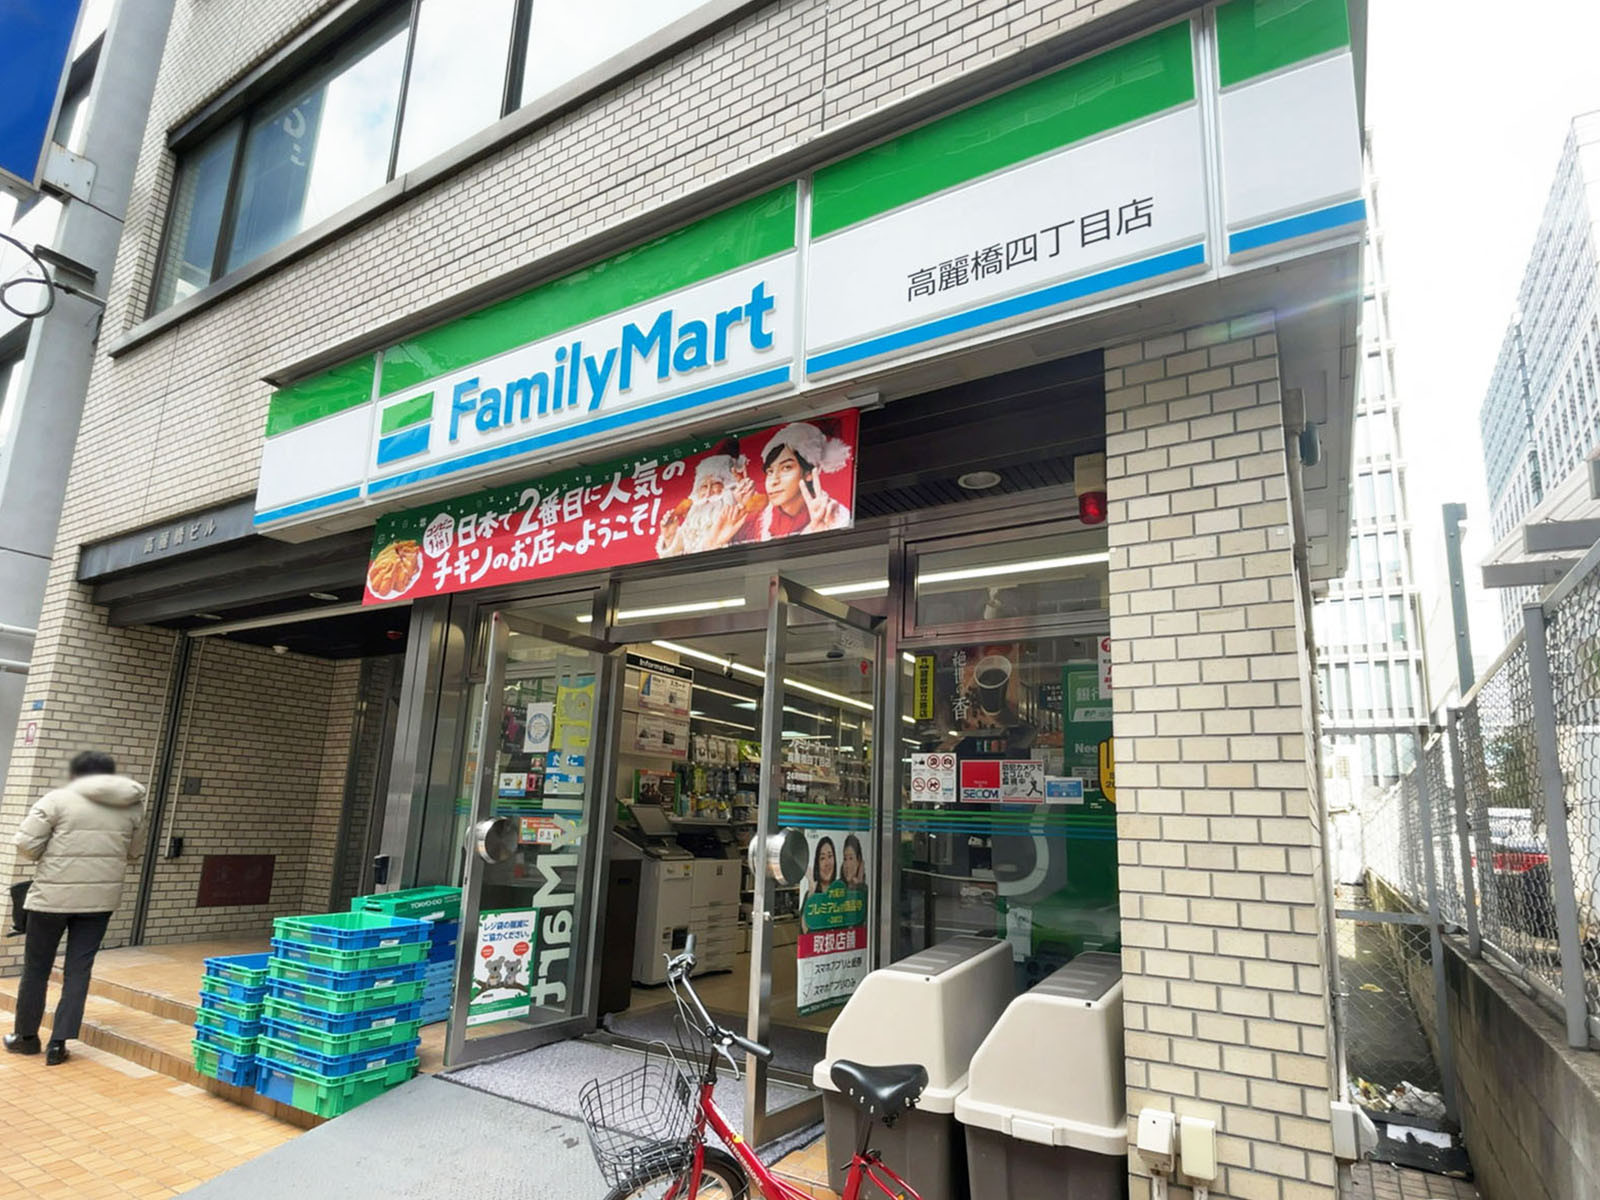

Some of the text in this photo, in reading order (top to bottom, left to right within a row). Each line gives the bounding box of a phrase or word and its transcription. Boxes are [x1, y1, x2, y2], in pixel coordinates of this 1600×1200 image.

[907, 196, 1154, 302] 高麗橋四丁目店
[448, 281, 776, 443] FamilyMart
[456, 458, 686, 548] 日本で2番目に人気の
[963, 789, 999, 798] SECOM
[813, 930, 856, 954] 取扱店舗
